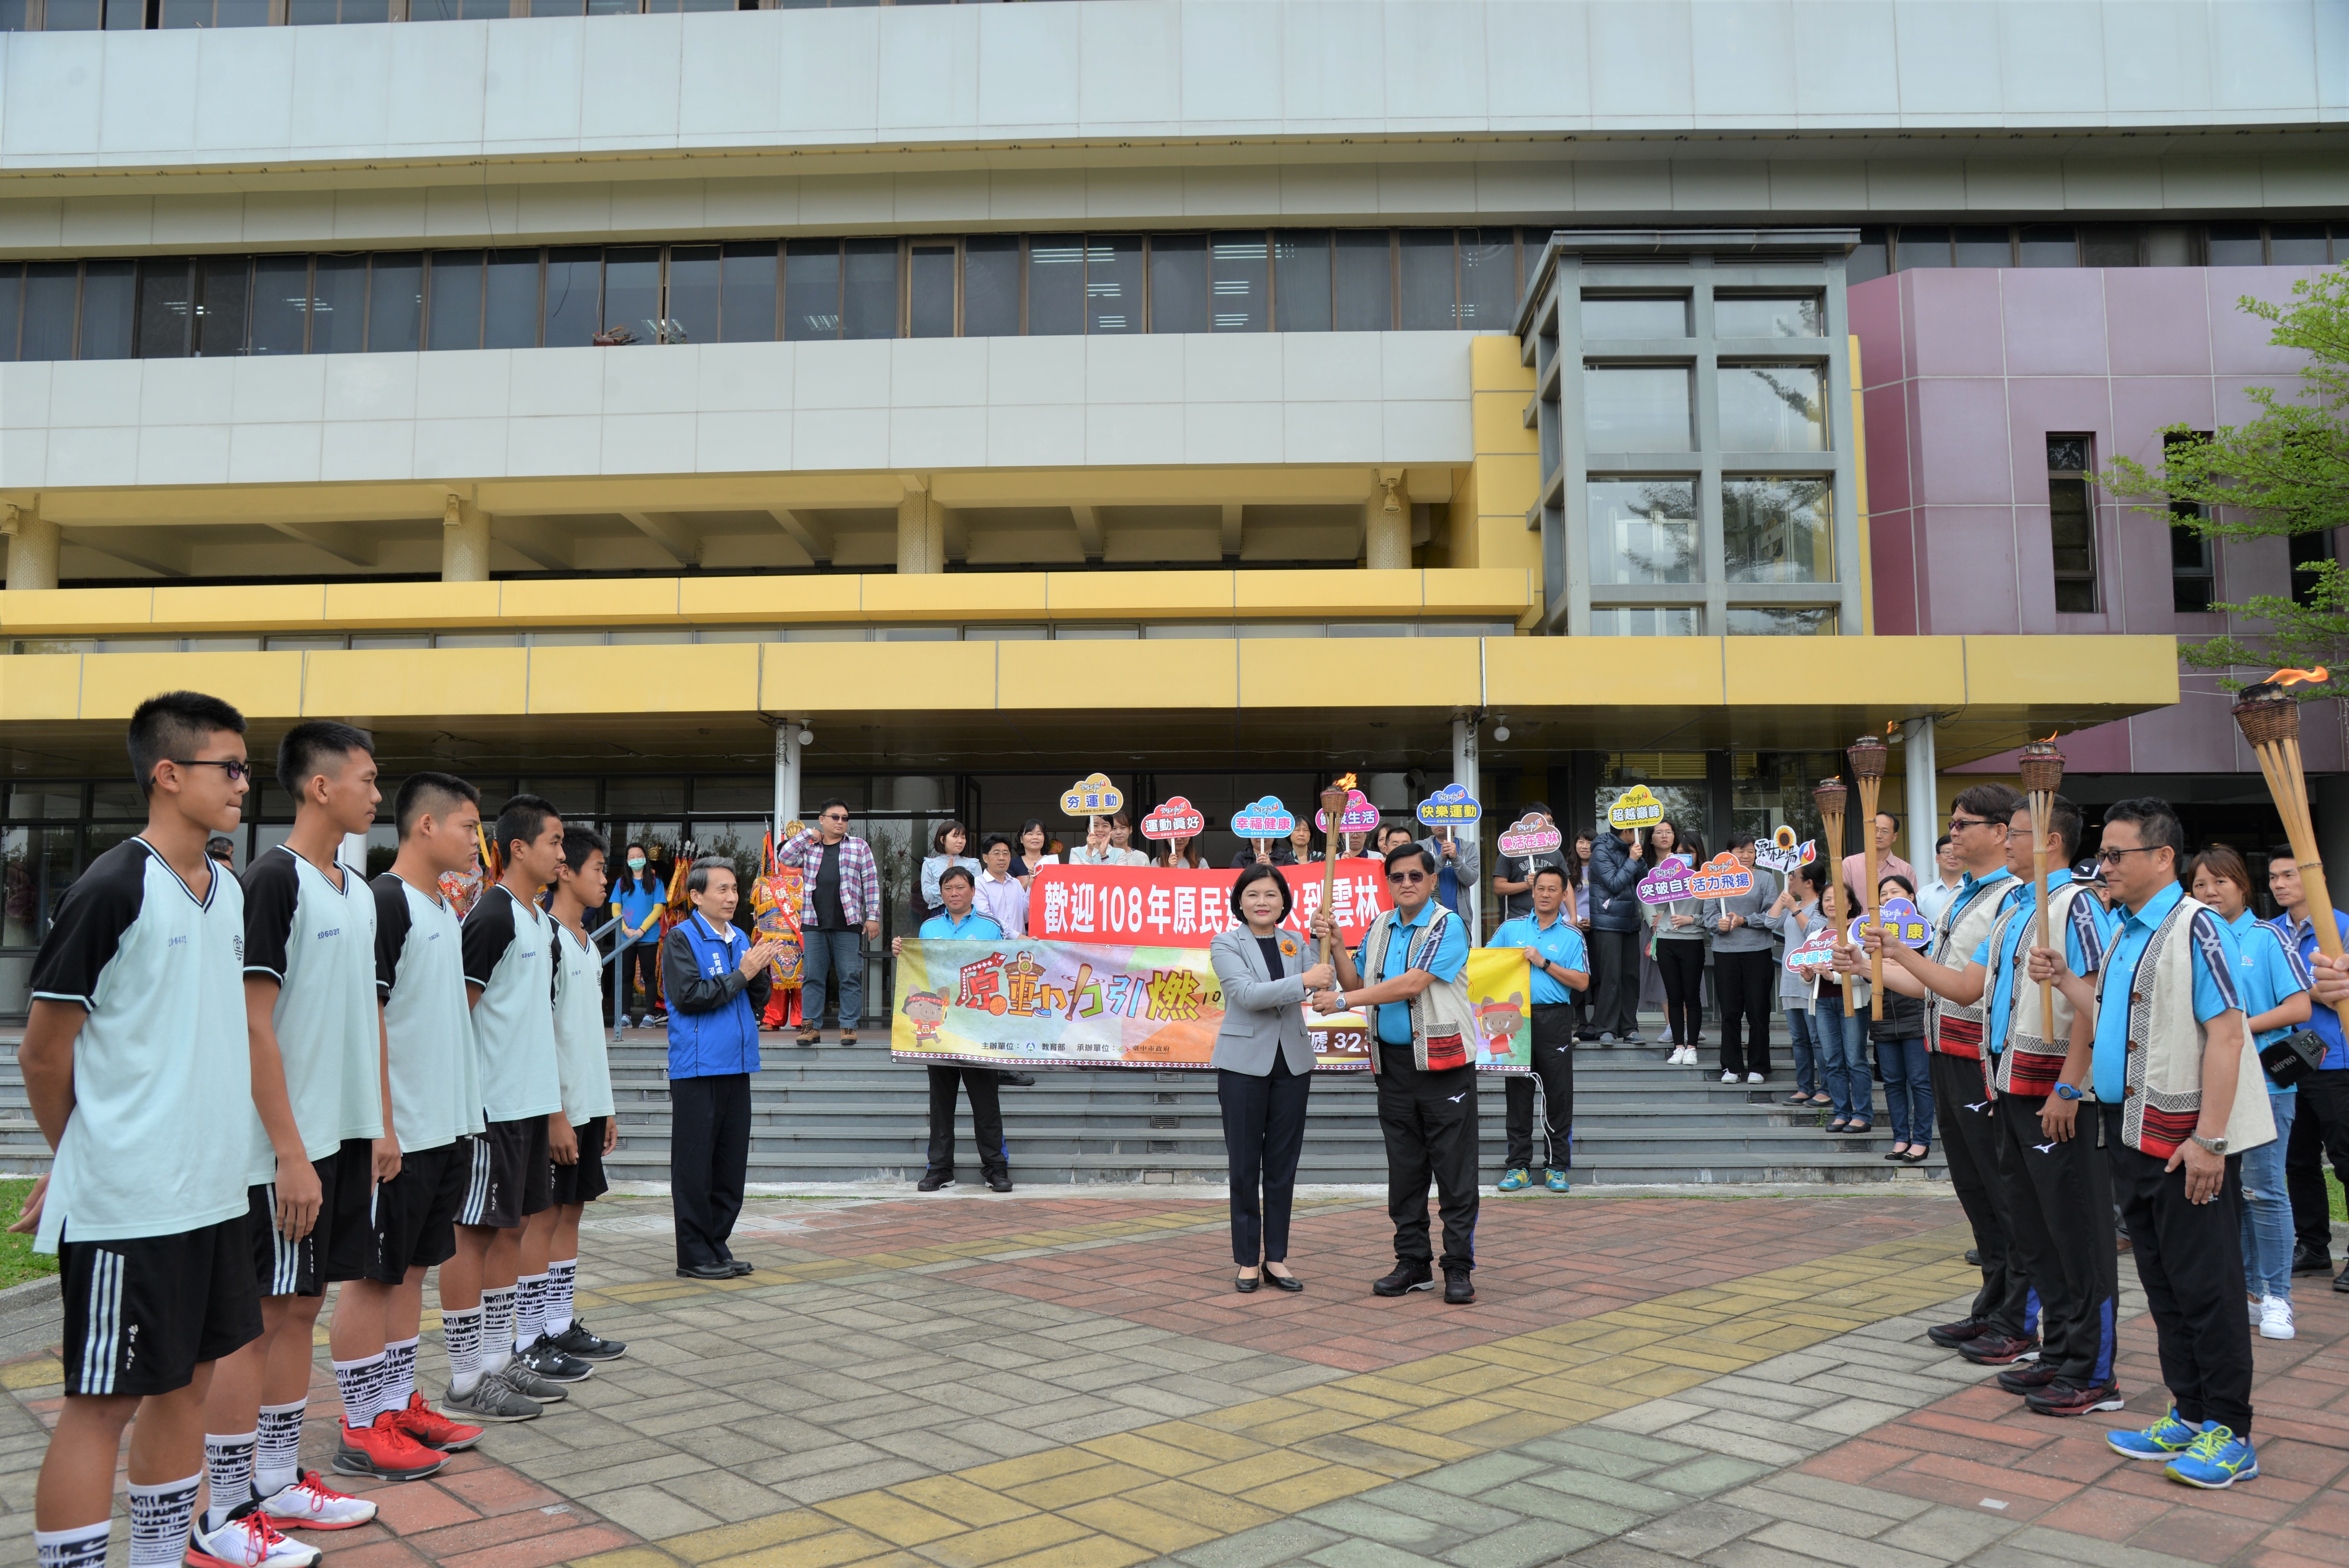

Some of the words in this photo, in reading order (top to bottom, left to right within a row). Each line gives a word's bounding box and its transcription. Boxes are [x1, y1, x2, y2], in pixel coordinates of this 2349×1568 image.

[1067, 794, 1117, 808] 夯運動
[1421, 804, 1477, 818] 快樂運動
[1612, 805, 1660, 822] 超越巔峰
[1236, 817, 1291, 830] 幸福健康
[1501, 831, 1559, 851] 樂活在雲林
[1693, 873, 1749, 893] 活力飛揚
[317, 928, 340, 939] 106037
[712, 953, 724, 974] 教育處
[955, 951, 1201, 1022] 原動力引燃
[1041, 1042, 1066, 1051] 教育部
